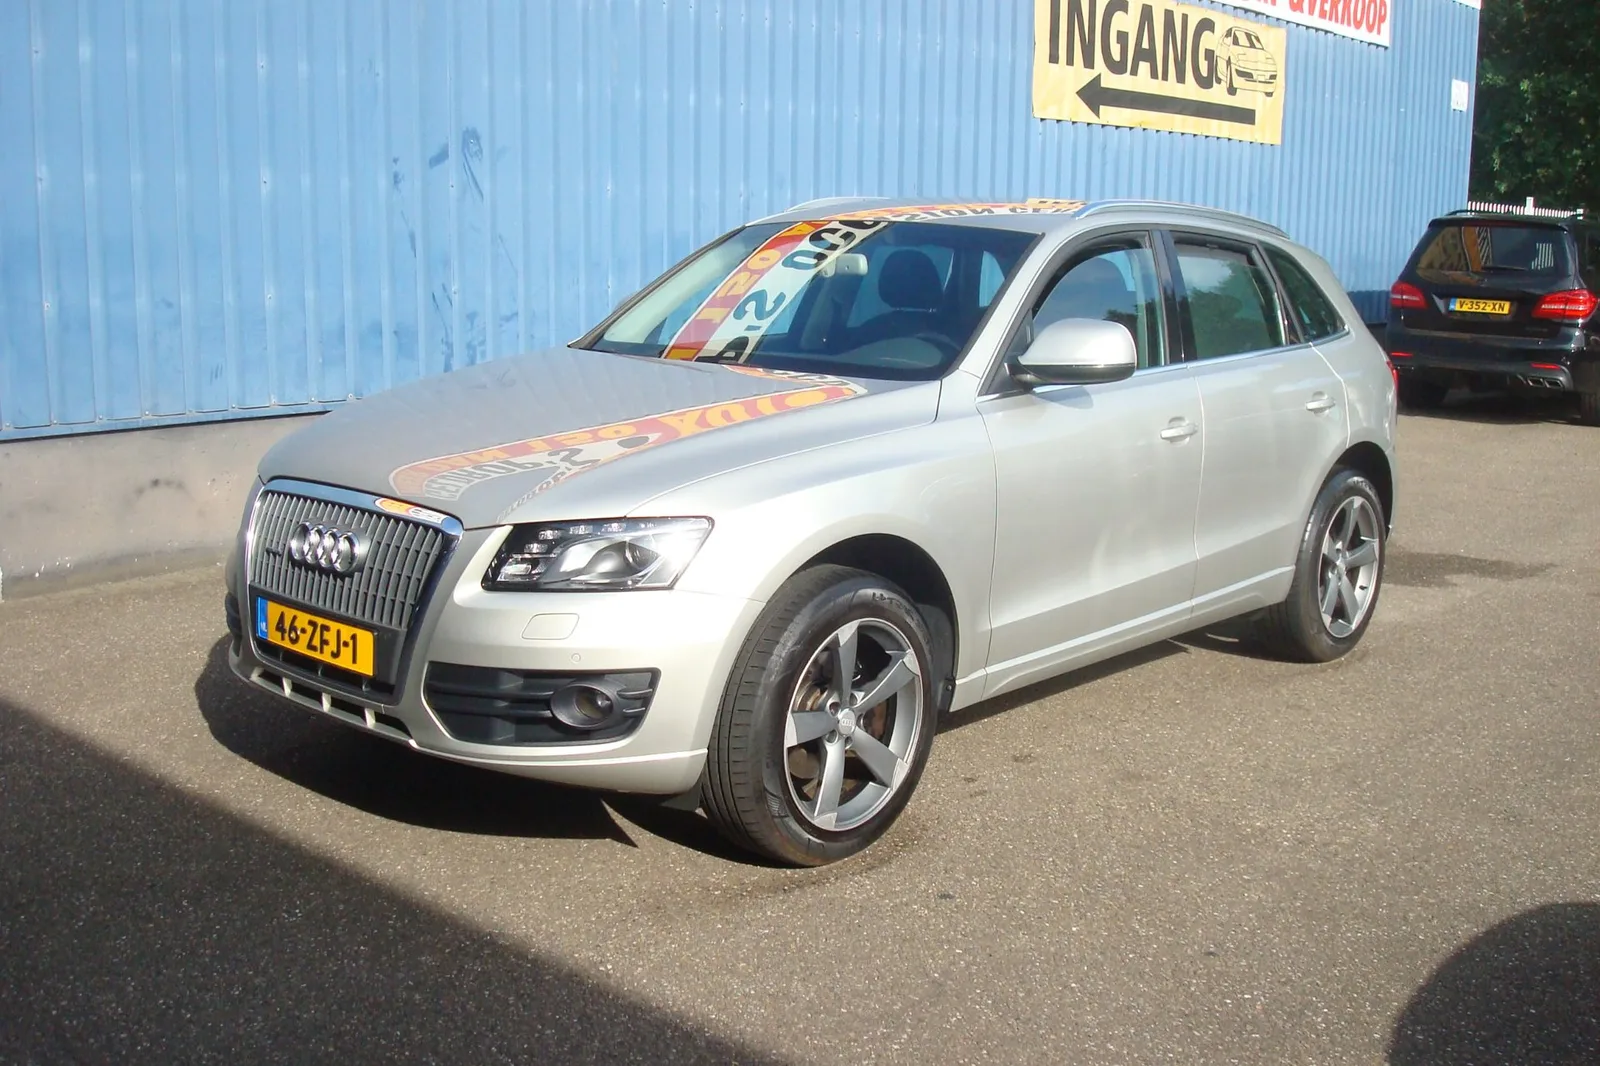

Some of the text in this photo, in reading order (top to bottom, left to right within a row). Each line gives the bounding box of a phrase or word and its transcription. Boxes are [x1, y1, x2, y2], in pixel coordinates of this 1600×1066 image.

[1049, 0, 1215, 89] INGANG
[1459, 300, 1506, 312] V-352-XN
[275, 611, 357, 664] 46-ZFJ-1
